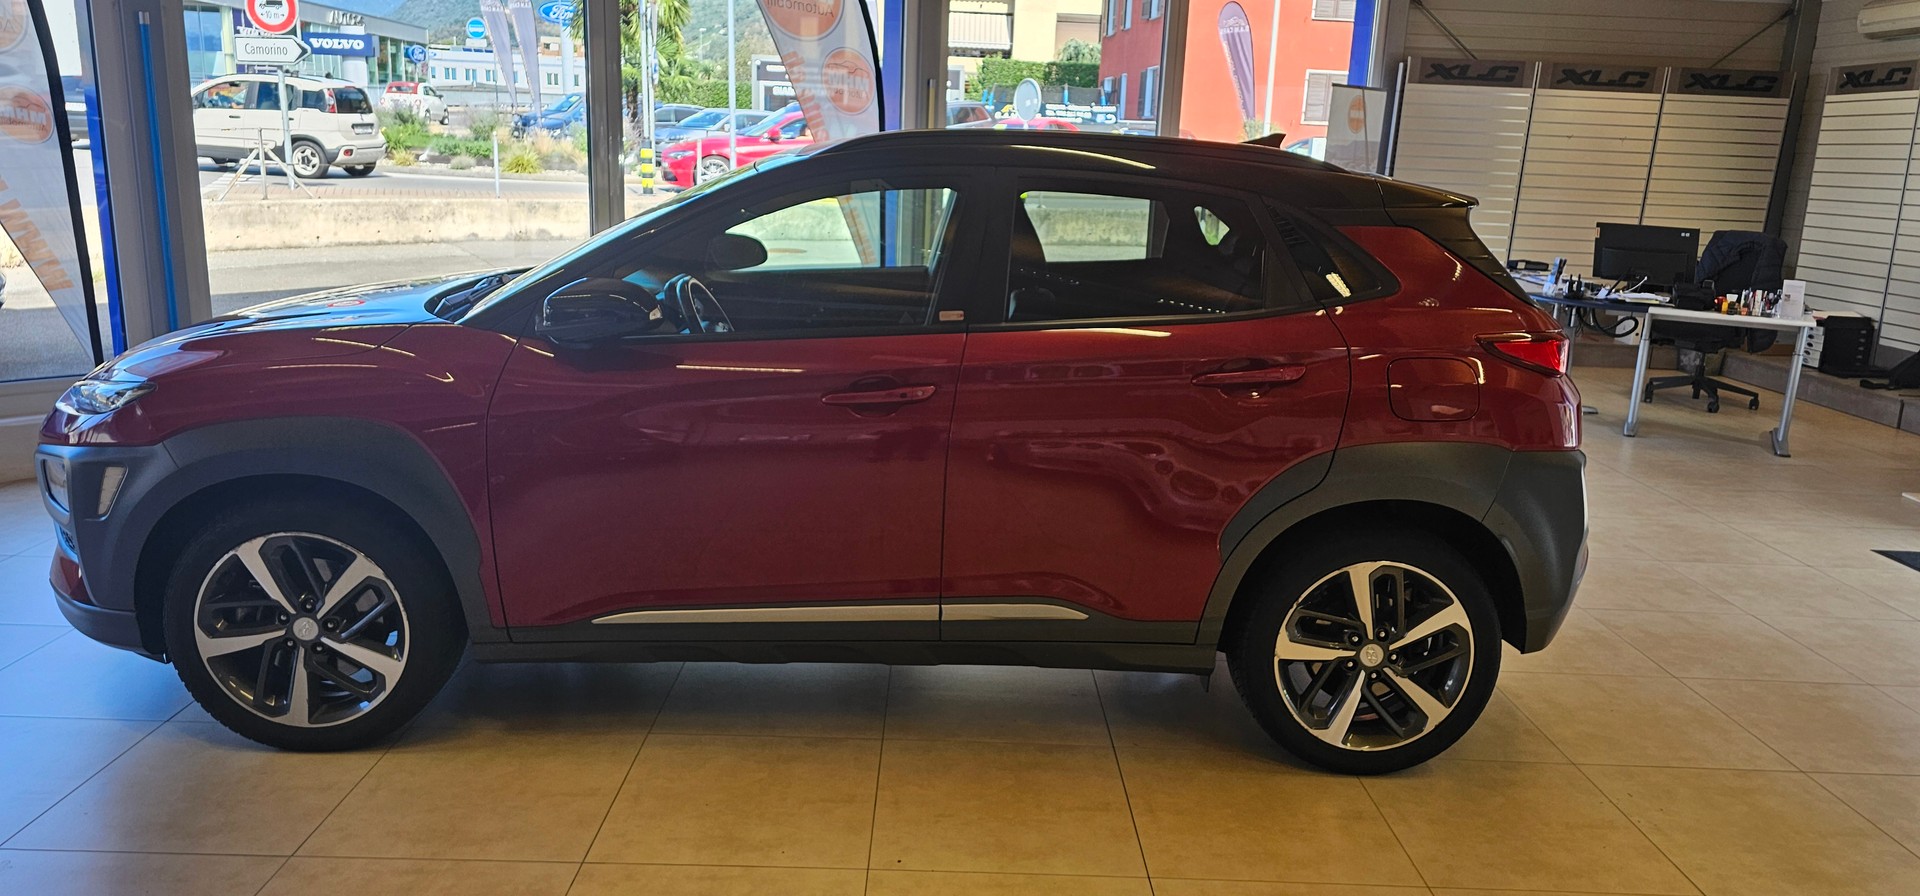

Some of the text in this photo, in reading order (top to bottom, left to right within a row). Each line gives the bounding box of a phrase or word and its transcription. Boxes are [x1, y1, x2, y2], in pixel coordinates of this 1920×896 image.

[244, 43, 288, 56] Camorino
[309, 38, 365, 50] VOLVO
[1425, 63, 1519, 83] XLC
[1557, 68, 1650, 88] XLC
[1684, 73, 1778, 92] XLC
[1839, 67, 1912, 89] XLC
